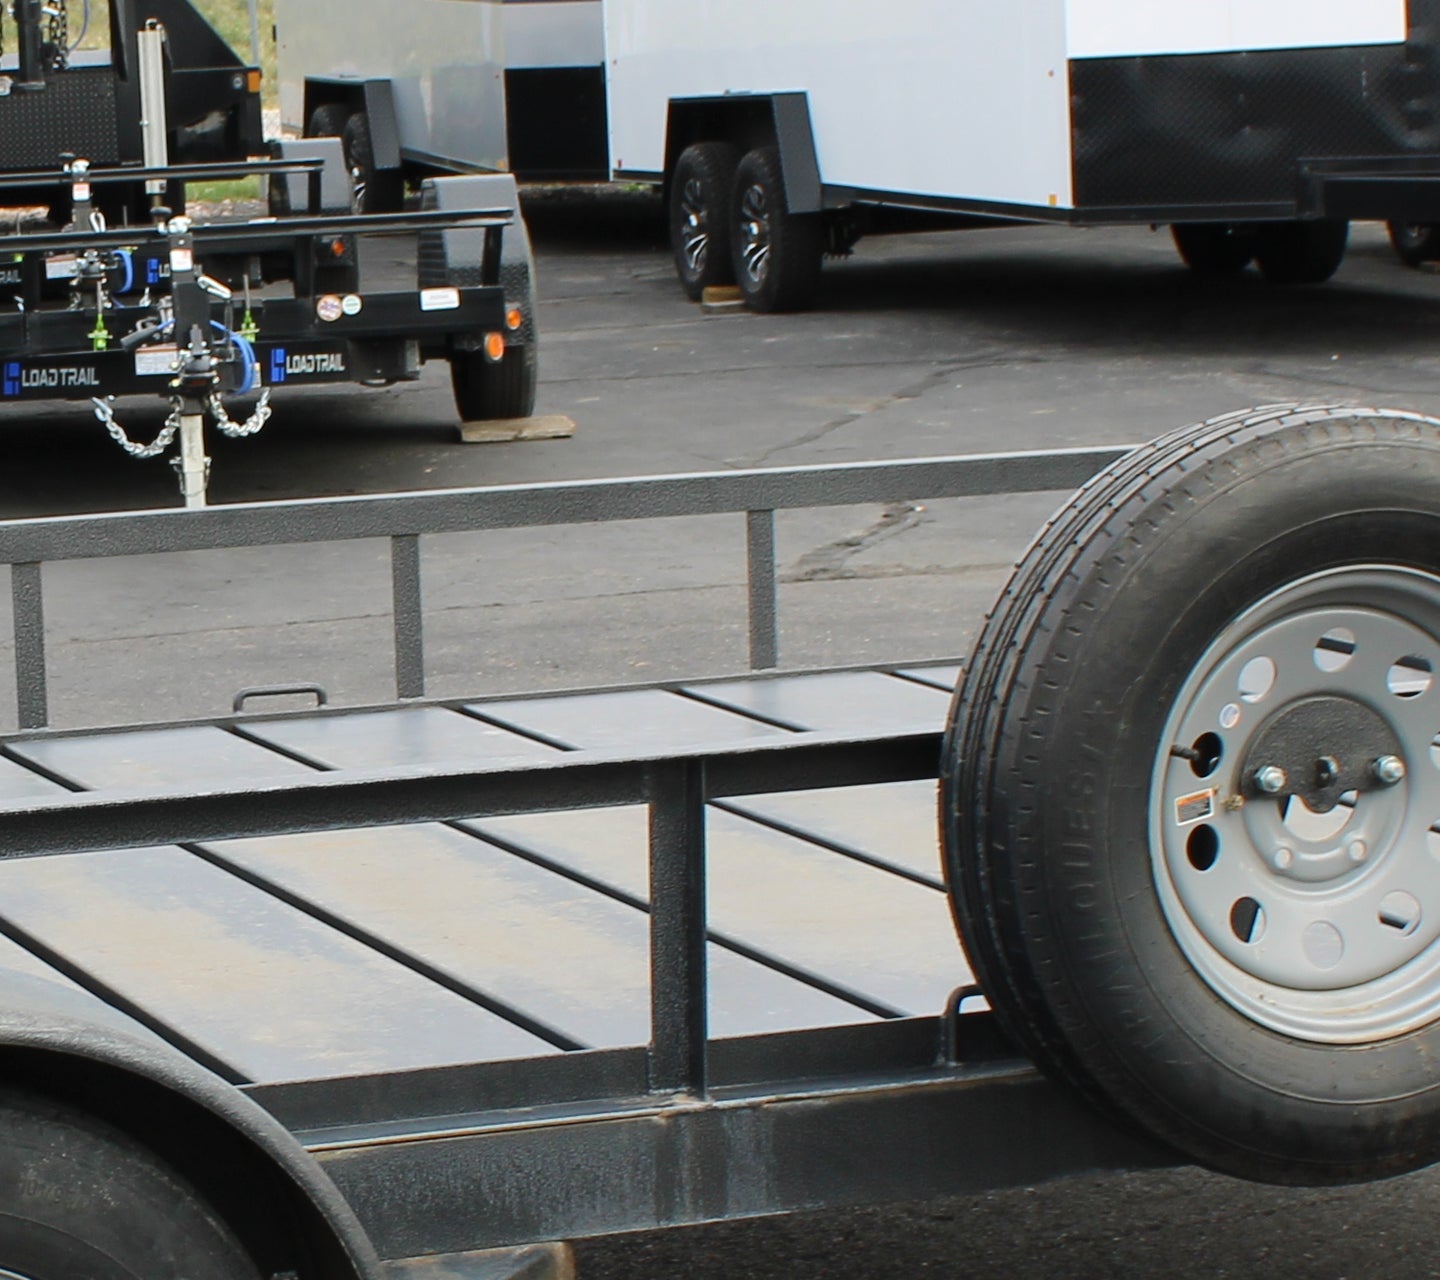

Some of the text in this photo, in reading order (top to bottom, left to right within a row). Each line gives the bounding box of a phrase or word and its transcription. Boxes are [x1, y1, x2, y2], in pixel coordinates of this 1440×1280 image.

[286, 353, 345, 374] LOAD TRAIL
[22, 367, 99, 387] LOAD TRAIL
